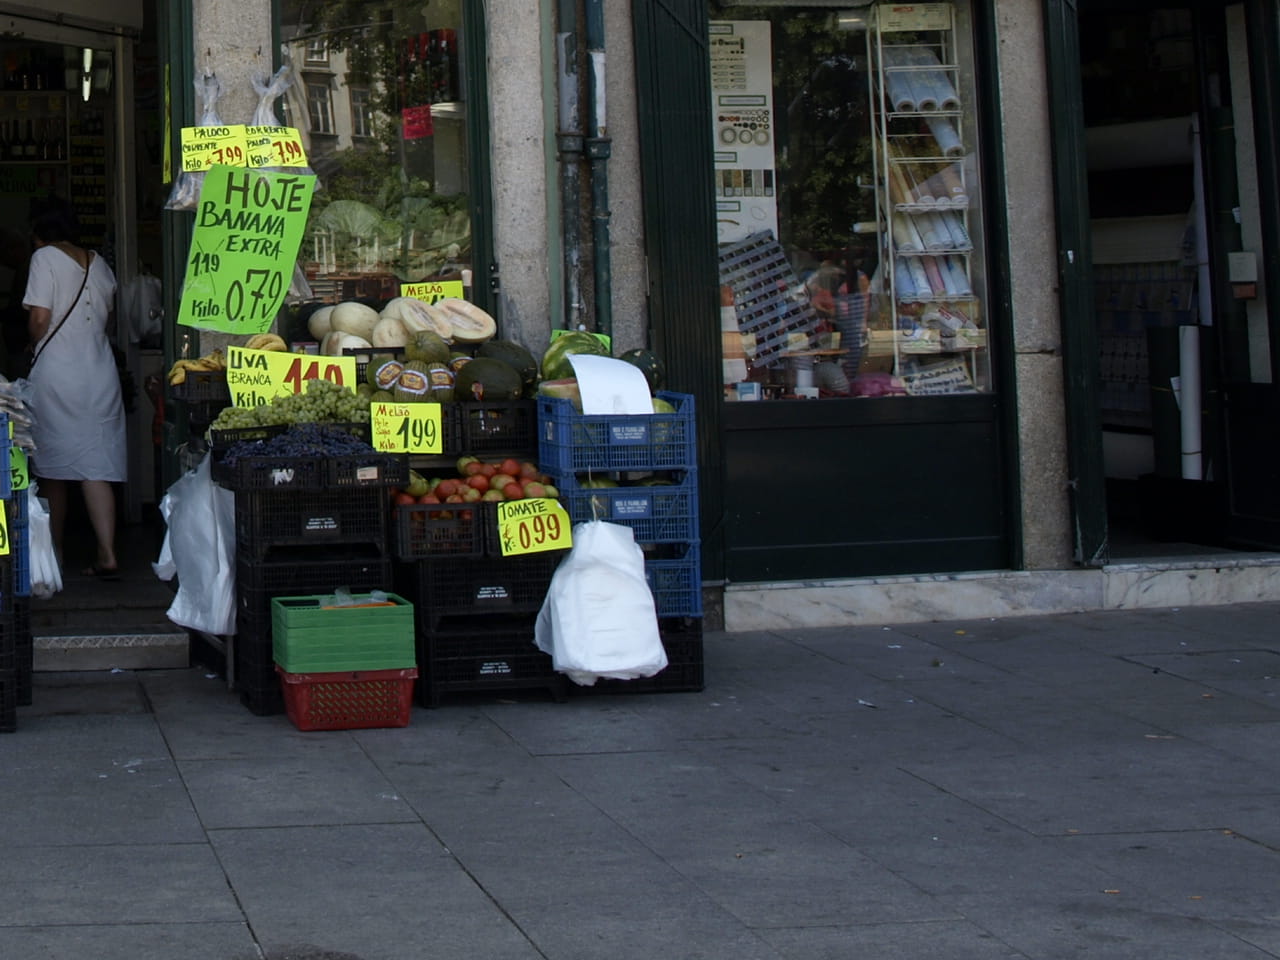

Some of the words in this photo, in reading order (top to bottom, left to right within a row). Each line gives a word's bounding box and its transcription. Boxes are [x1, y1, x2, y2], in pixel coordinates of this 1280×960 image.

[185, 158, 202, 170] Kilo
[224, 171, 306, 213] HOJE
[198, 200, 286, 239] BANANA
[225, 234, 283, 262] EXTRA
[225, 268, 283, 322] 0.79
[230, 349, 268, 371] UVA
[229, 370, 272, 386] BRANCA
[498, 499, 548, 521] TOMATE
[518, 513, 561, 550] 0.99
